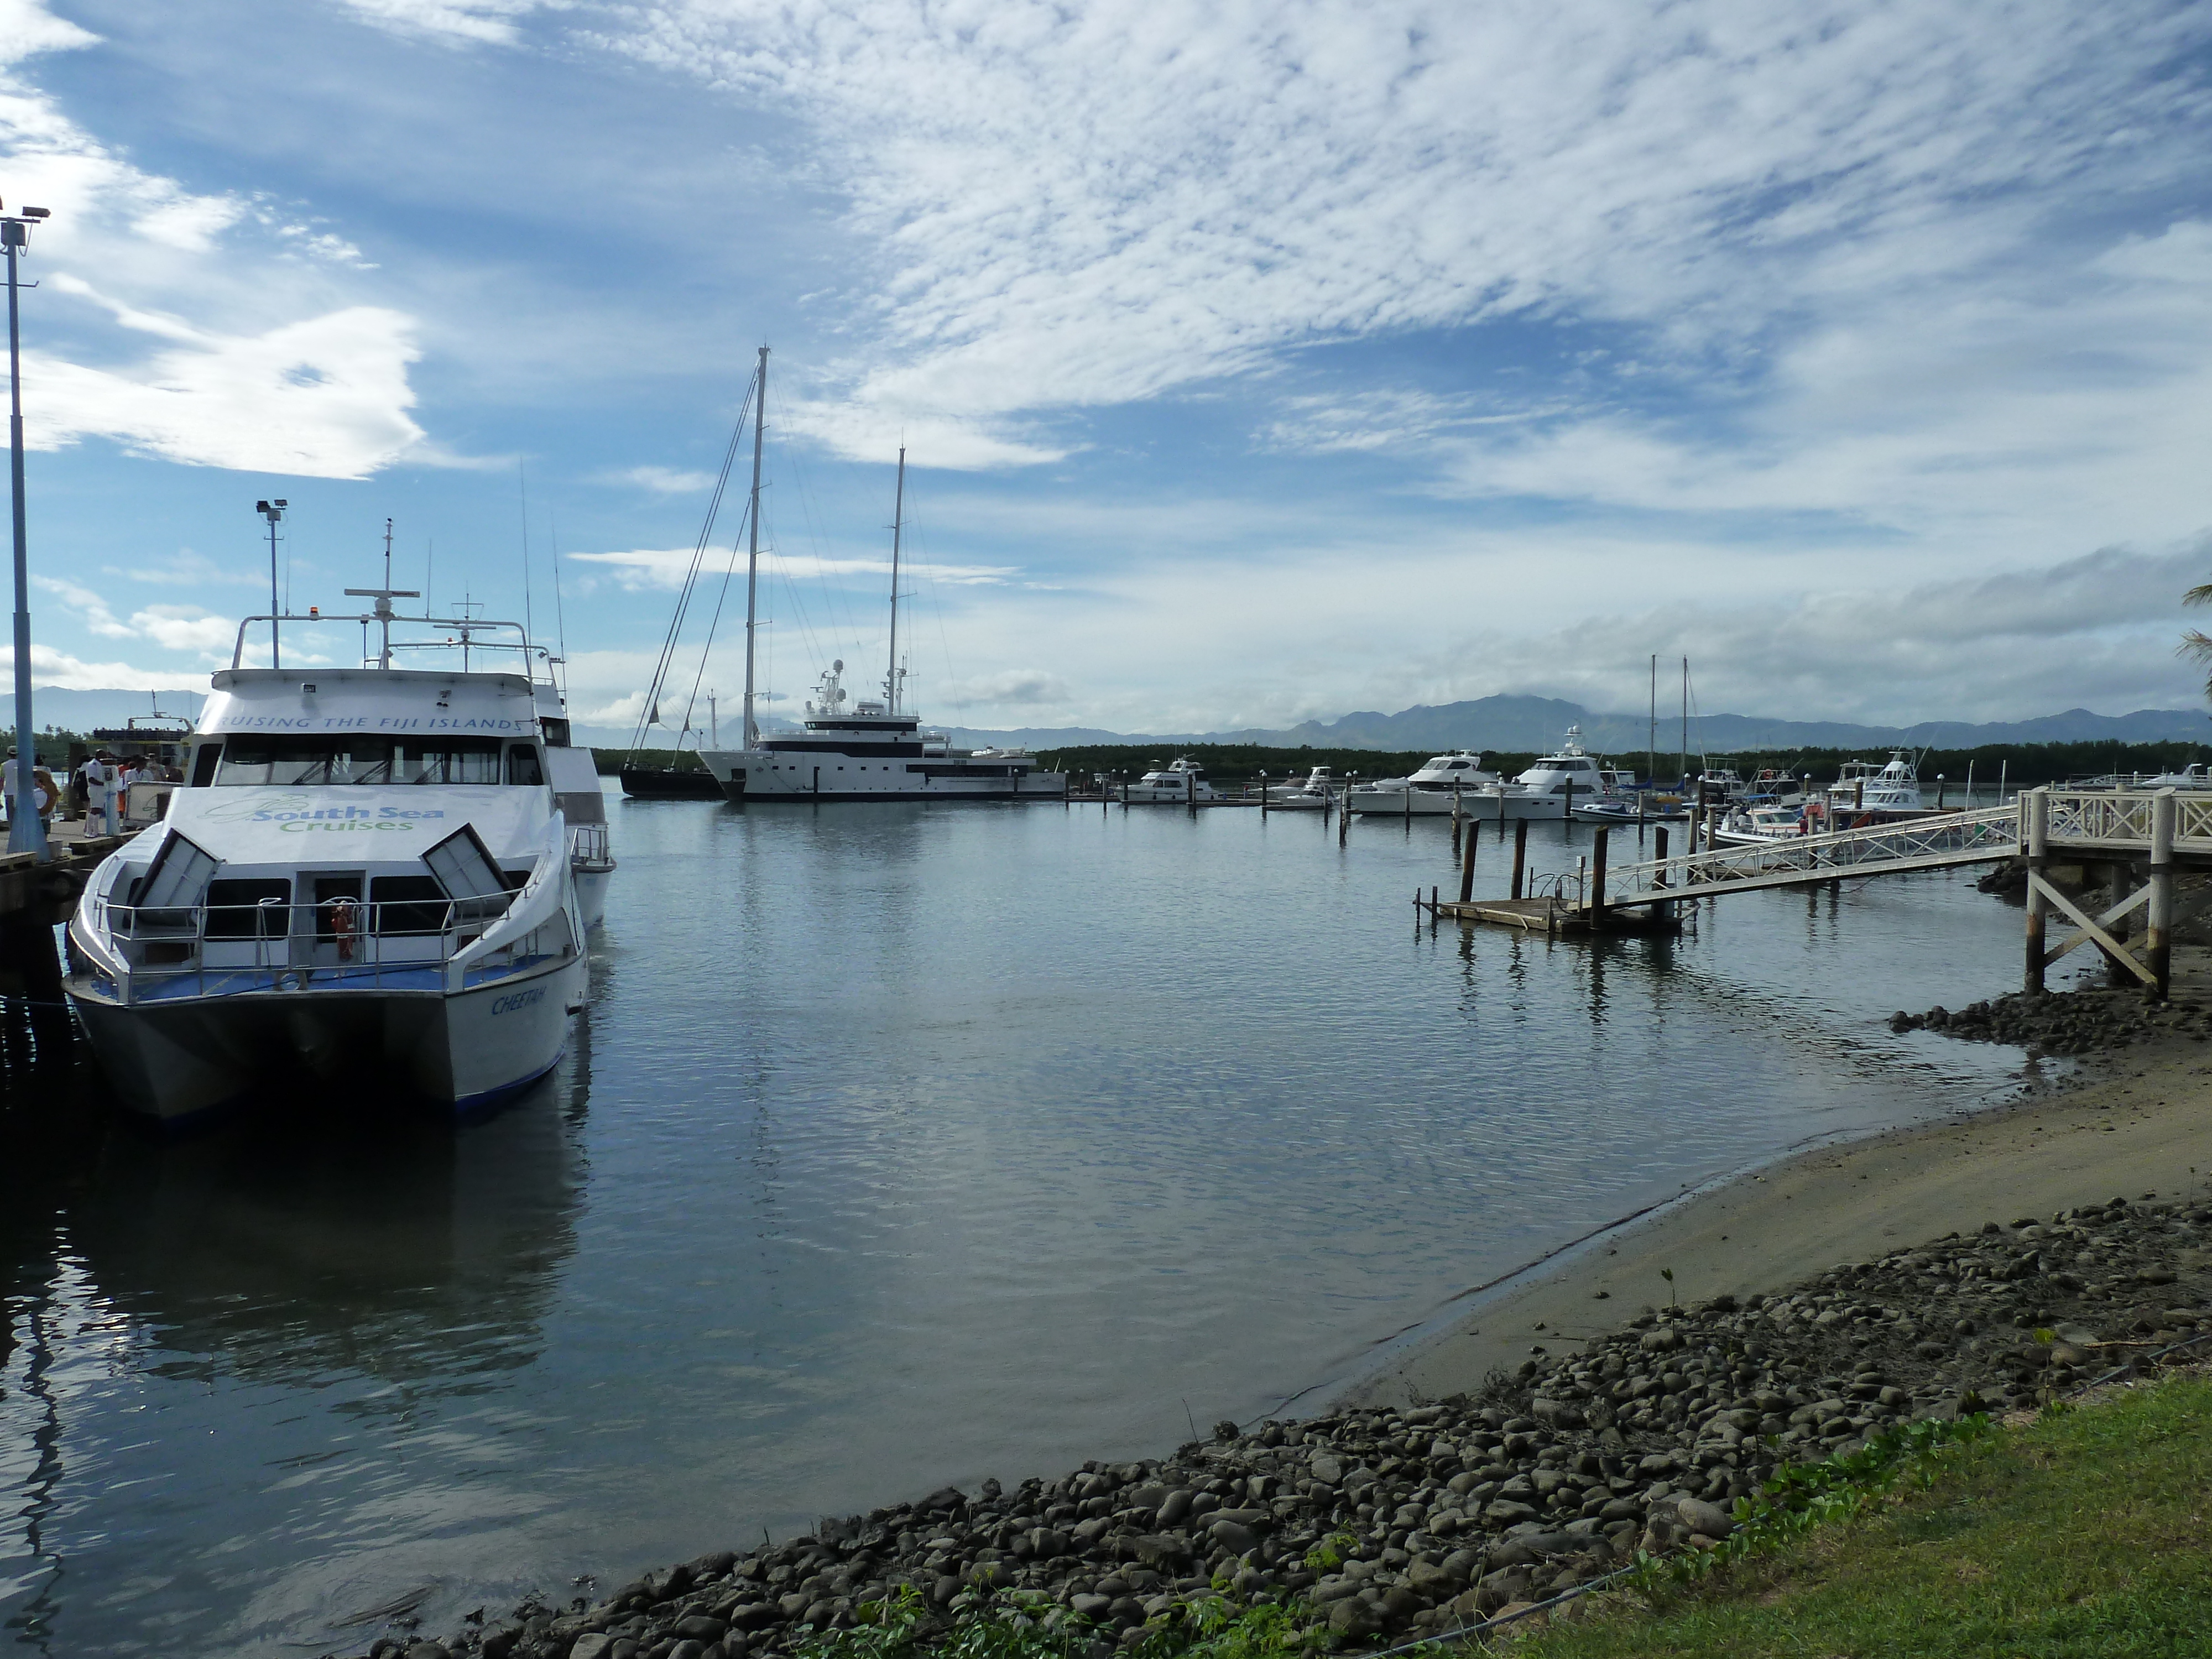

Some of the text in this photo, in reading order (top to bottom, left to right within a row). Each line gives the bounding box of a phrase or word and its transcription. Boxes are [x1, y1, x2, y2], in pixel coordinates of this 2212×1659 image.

[324, 718, 368, 728] THE
[379, 718, 418, 729] FIJI
[429, 718, 523, 731] ISLANDS
[252, 805, 445, 822] South Sea
[280, 819, 414, 832] Cruises
